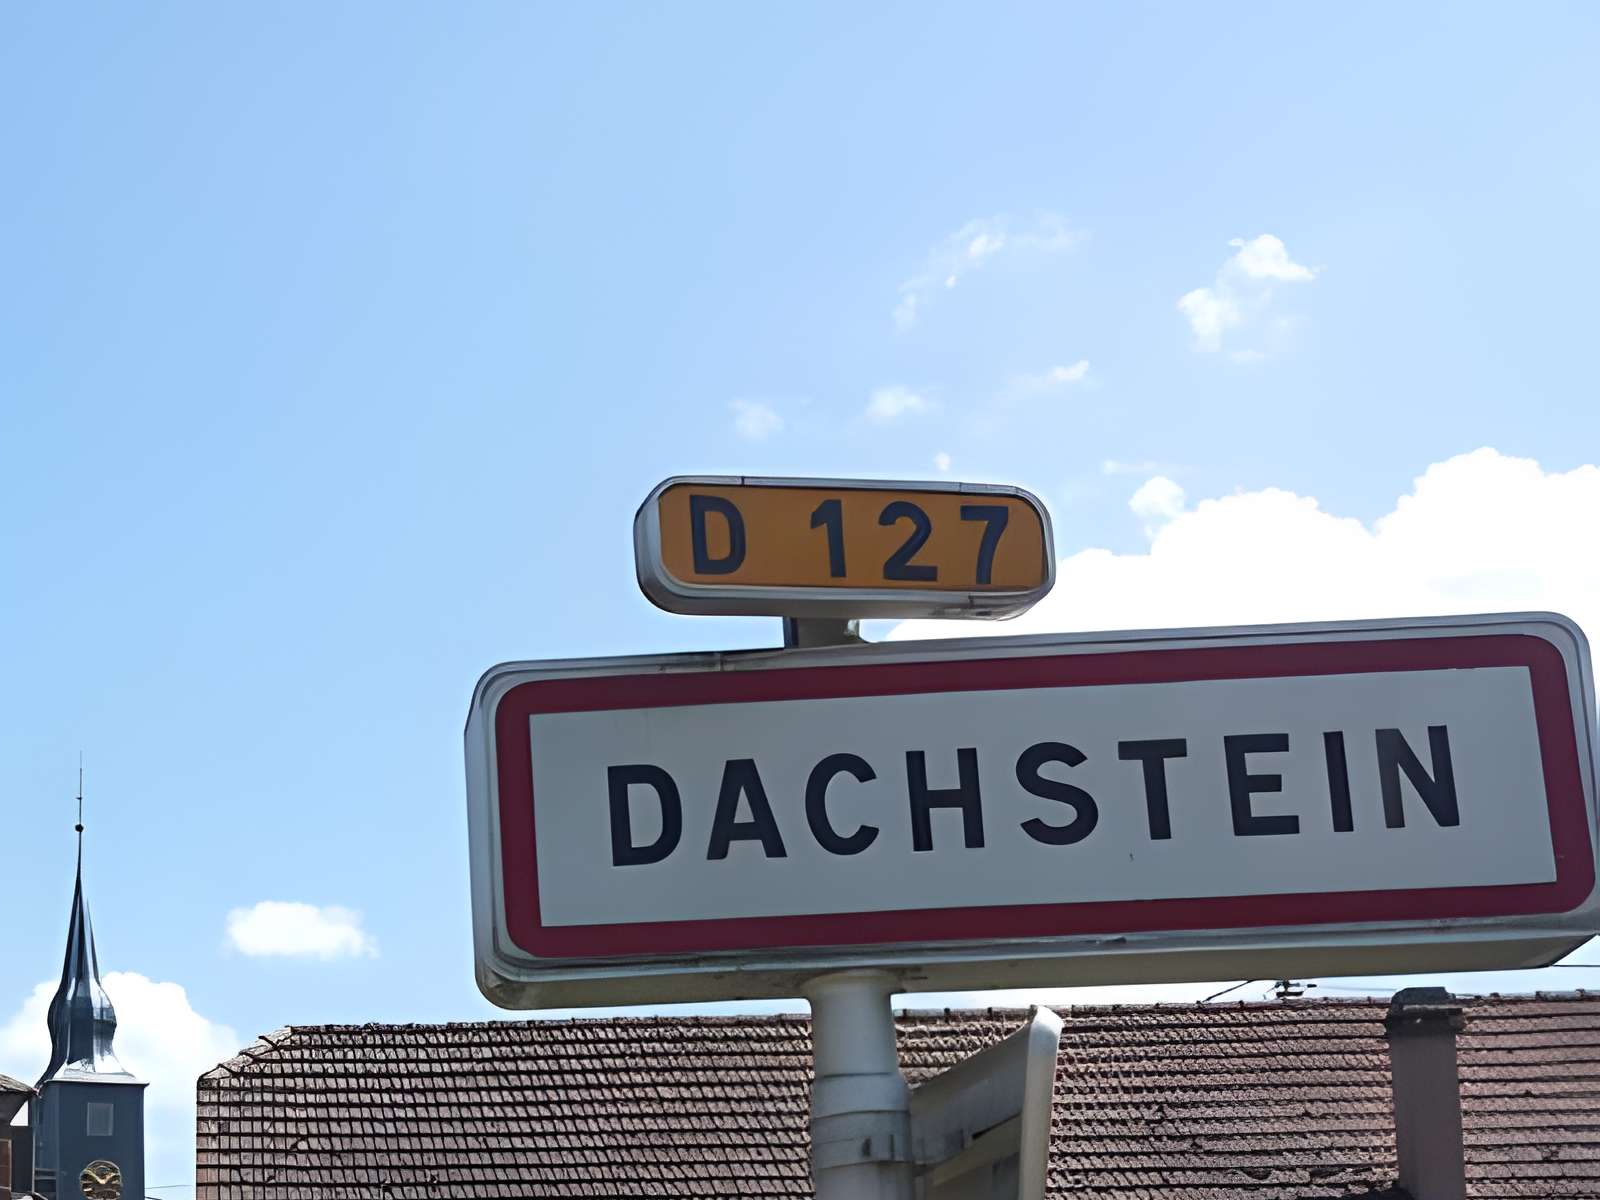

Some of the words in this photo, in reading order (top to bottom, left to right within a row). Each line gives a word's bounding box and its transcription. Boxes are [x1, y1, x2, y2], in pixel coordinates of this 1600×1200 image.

[687, 493, 748, 576] D
[809, 498, 1010, 584] 127
[607, 725, 1461, 867] DACHSTEIN
